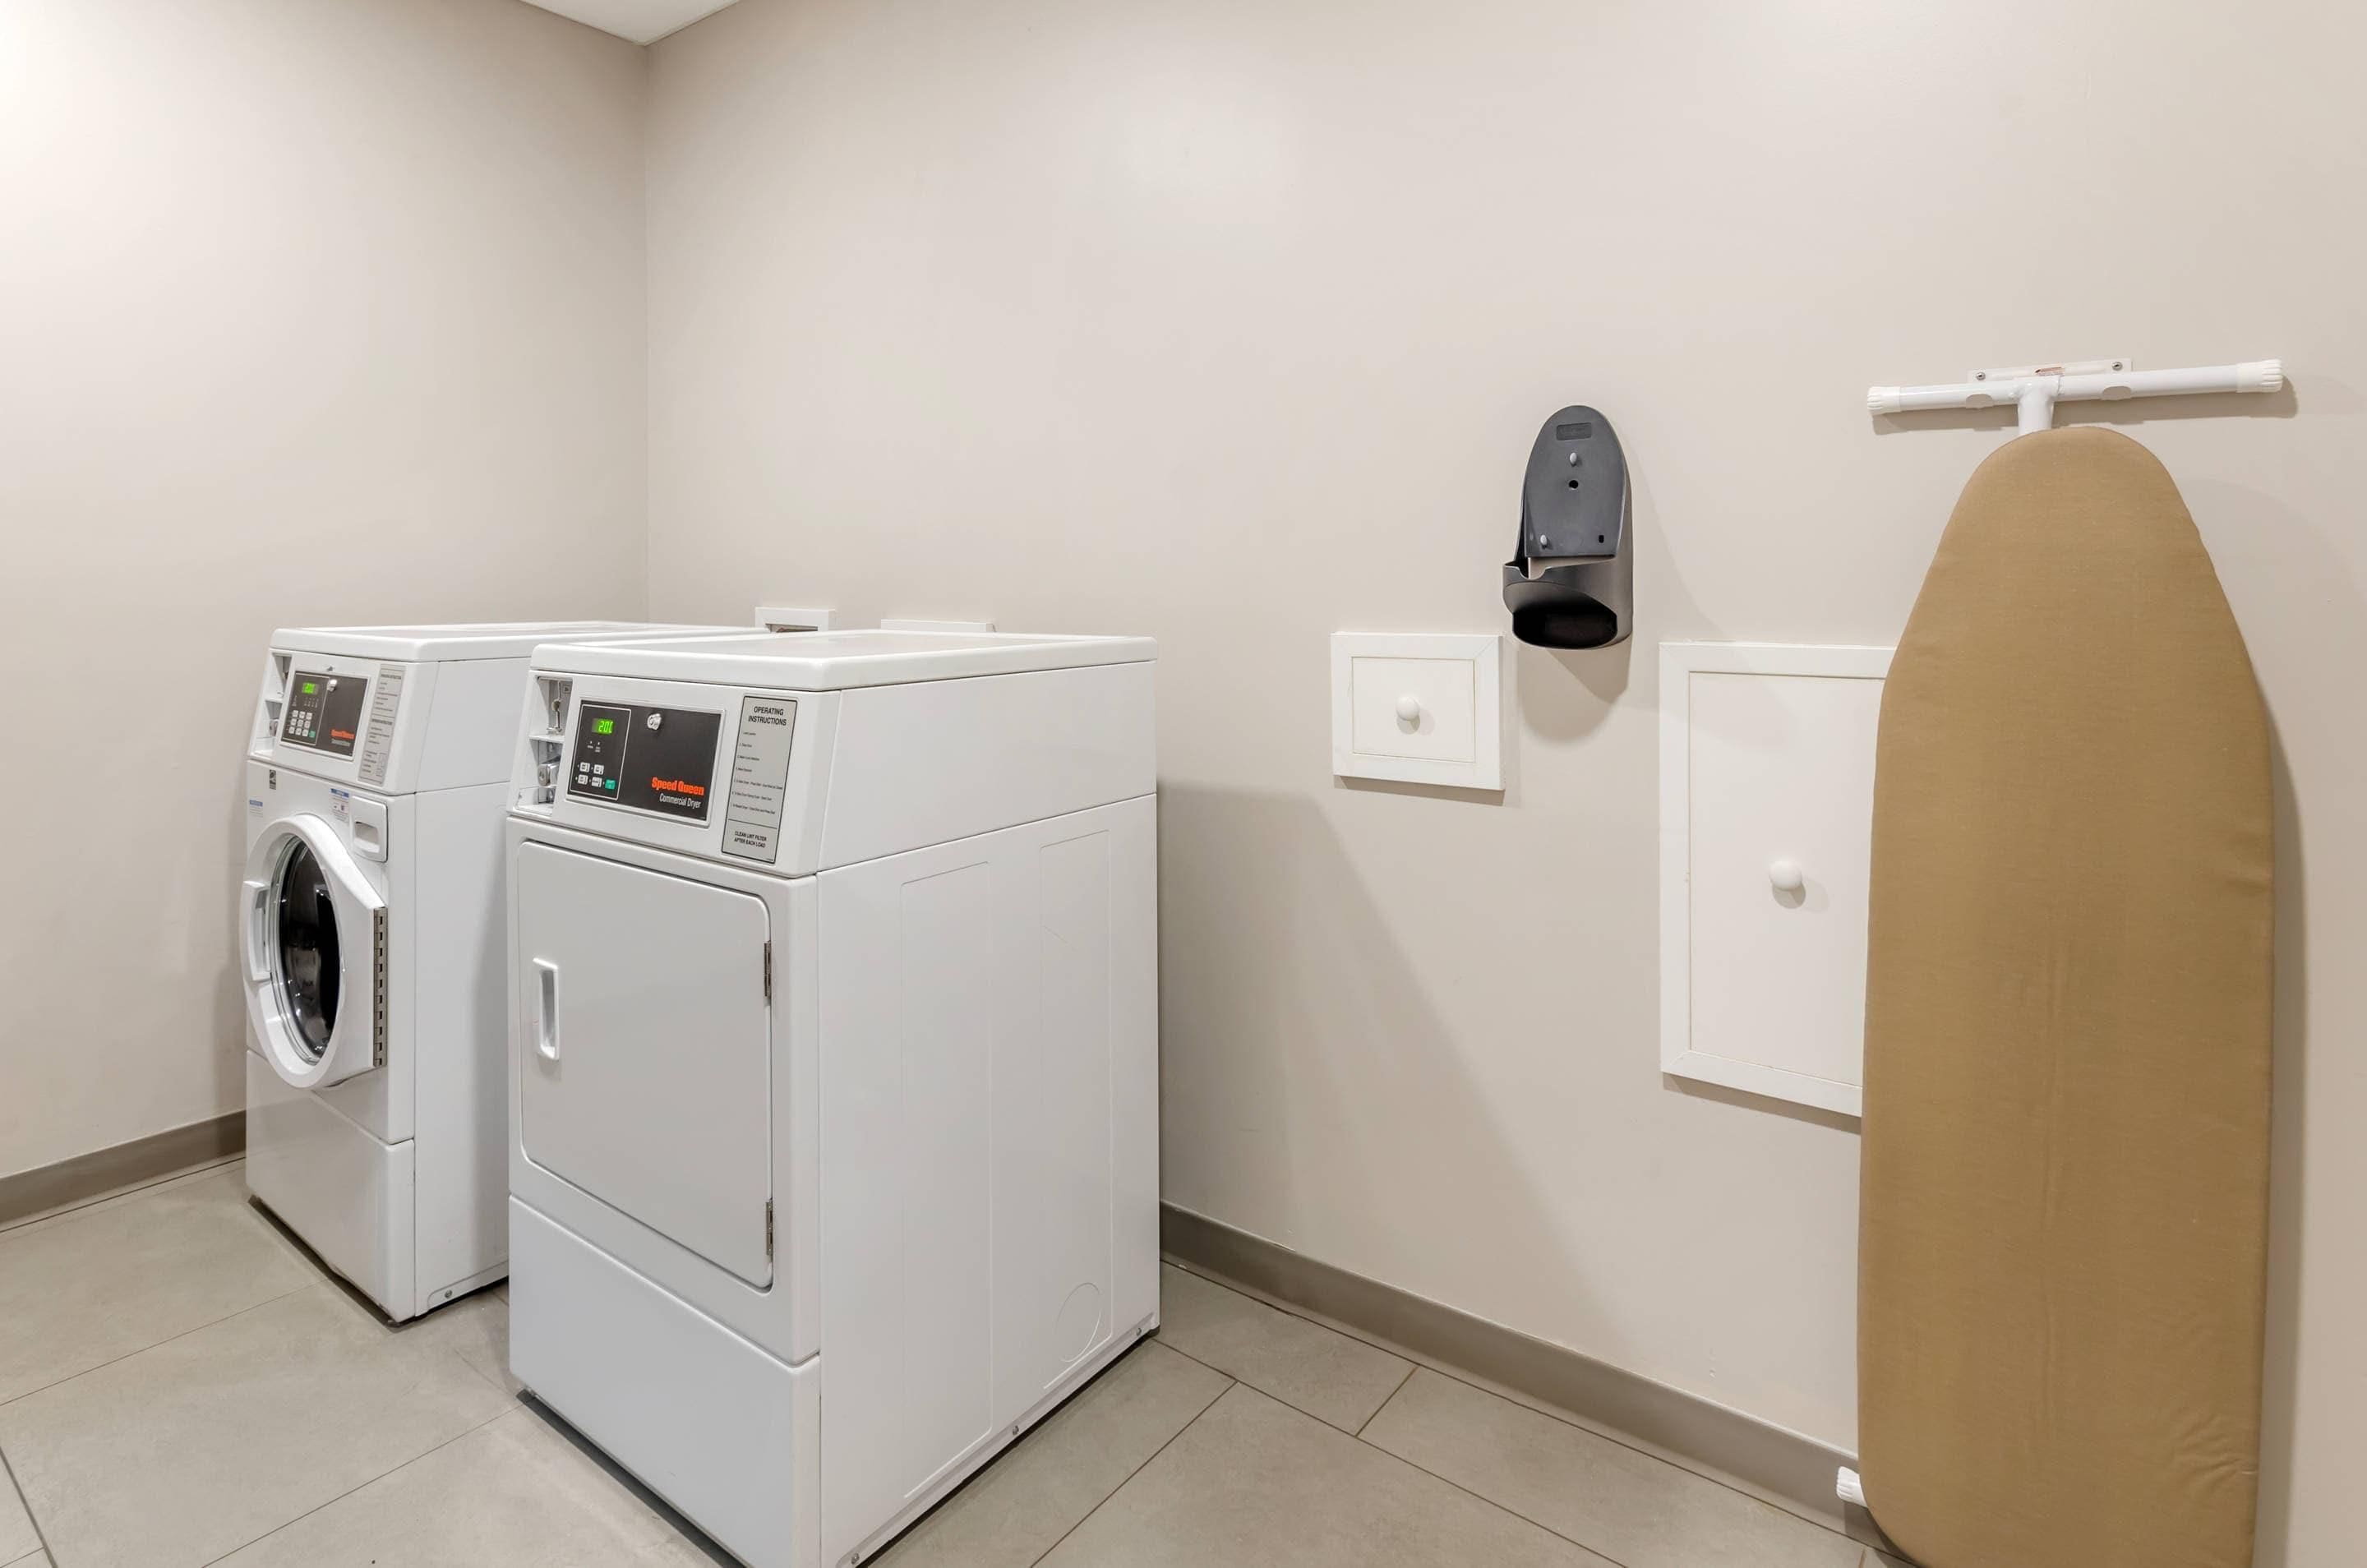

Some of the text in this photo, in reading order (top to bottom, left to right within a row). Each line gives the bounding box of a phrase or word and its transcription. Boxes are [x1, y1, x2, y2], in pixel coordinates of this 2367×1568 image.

[754, 706, 784, 716] OPERATING
[748, 715, 787, 726] INSTRUCTIONS
[652, 777, 704, 796] Speed Queen
[659, 792, 702, 809] Commercial Dryer
